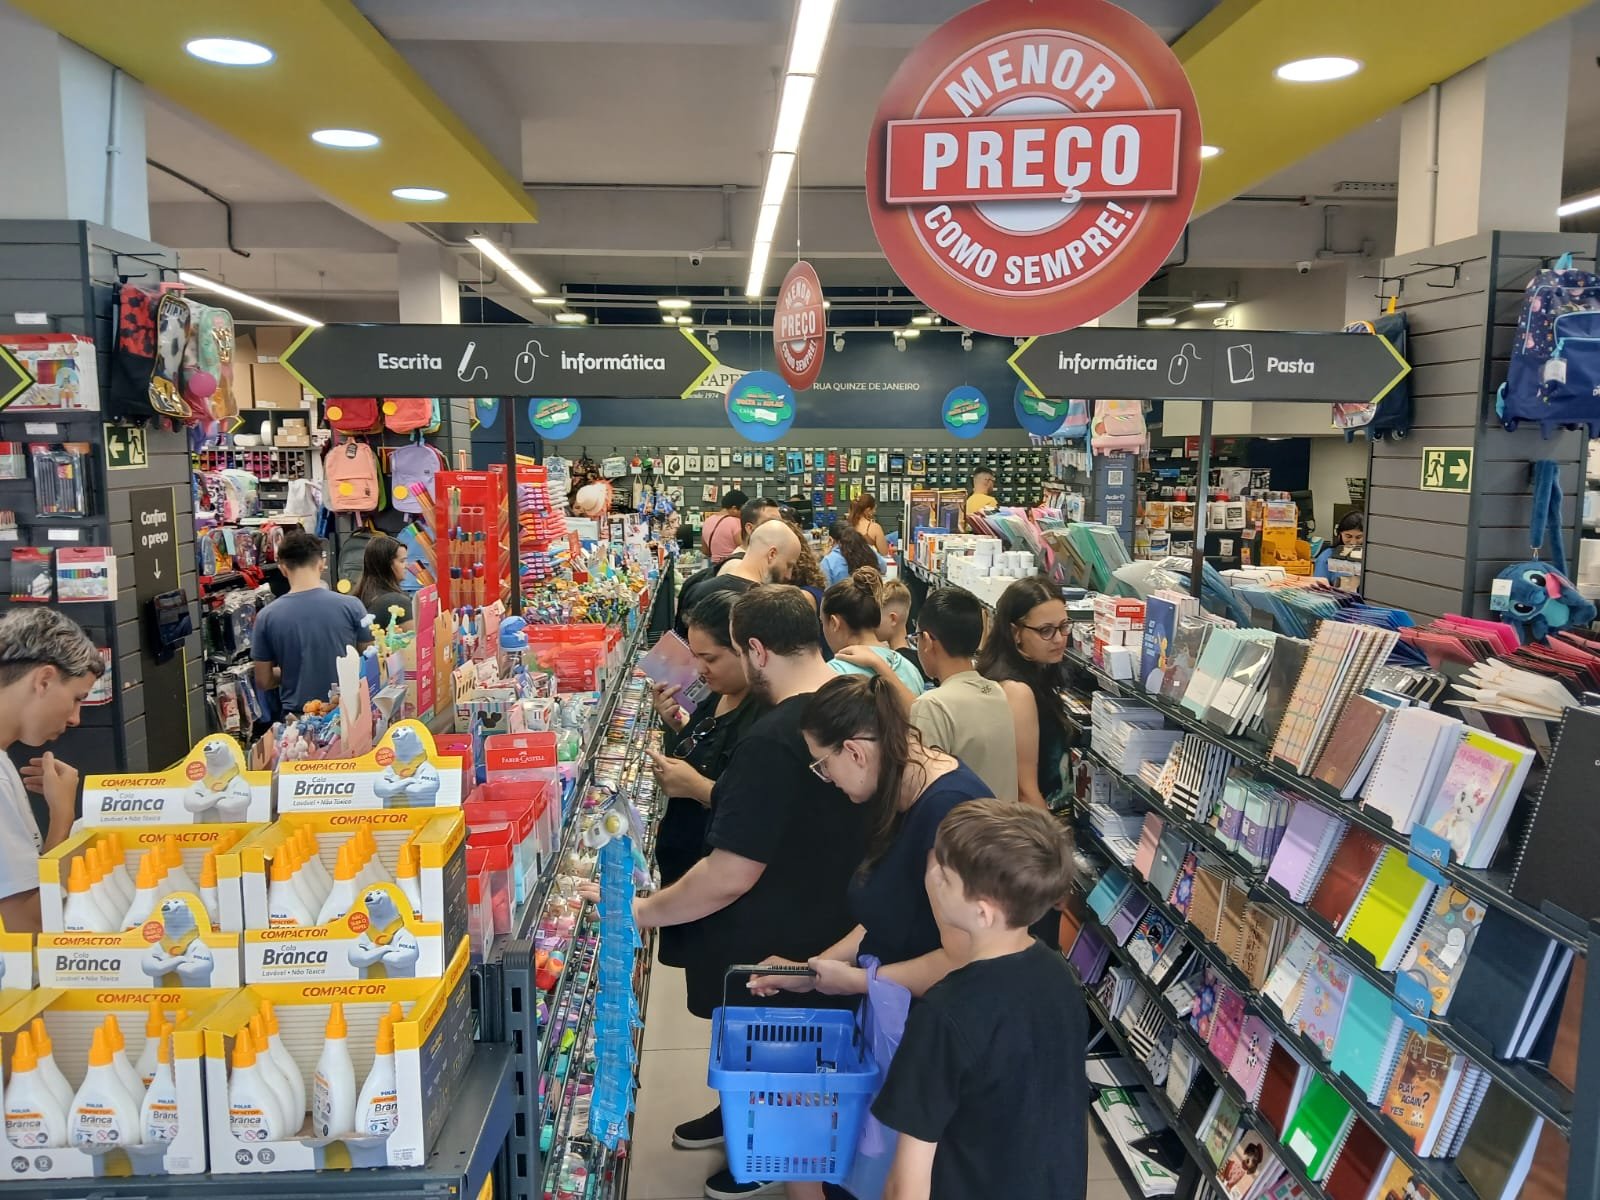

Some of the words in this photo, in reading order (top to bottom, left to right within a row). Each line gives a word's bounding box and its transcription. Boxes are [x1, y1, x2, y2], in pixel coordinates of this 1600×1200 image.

[944, 44, 1116, 118] MENOR
[922, 124, 1141, 204] PREÇO
[925, 204, 998, 278] COMO
[1004, 201, 1135, 285] SEMPRE!
[785, 281, 811, 310] MENOR
[781, 310, 816, 341] PREÇO
[378, 352, 442, 371] Escrita
[561, 350, 666, 374] Informática
[1058, 351, 1158, 374] Informática
[1266, 357, 1315, 374] Pasta
[701, 373, 742, 386] PAPE
[813, 382, 832, 391] RUA
[834, 382, 867, 391] QUINZE
[869, 382, 881, 391] DE
[882, 382, 920, 391] JANEIRO
[141, 508, 167, 527] Confira
[141, 535, 148, 546] o
[148, 532, 169, 549] preço
[294, 762, 356, 771] COMPACTOR
[101, 778, 166, 787] COMPACTOR
[294, 781, 356, 796] Branca
[101, 796, 165, 812] Branca
[330, 814, 408, 825] COMPACTOR
[138, 832, 219, 843] COMACTOR
[260, 928, 328, 939] COMPACTOR
[53, 937, 121, 946] COMPACTOR
[55, 955, 121, 971] Branca
[262, 949, 328, 966] Branca
[302, 984, 386, 997] COMPACTOR
[96, 993, 181, 1004] COMPACTOR
[1398, 1082, 1415, 1093] PLAY
[375, 1103, 398, 1112] Bran
[1391, 1106, 1404, 1116] YES
[80, 1114, 112, 1124] Branca
[153, 1111, 178, 1119] Branc
